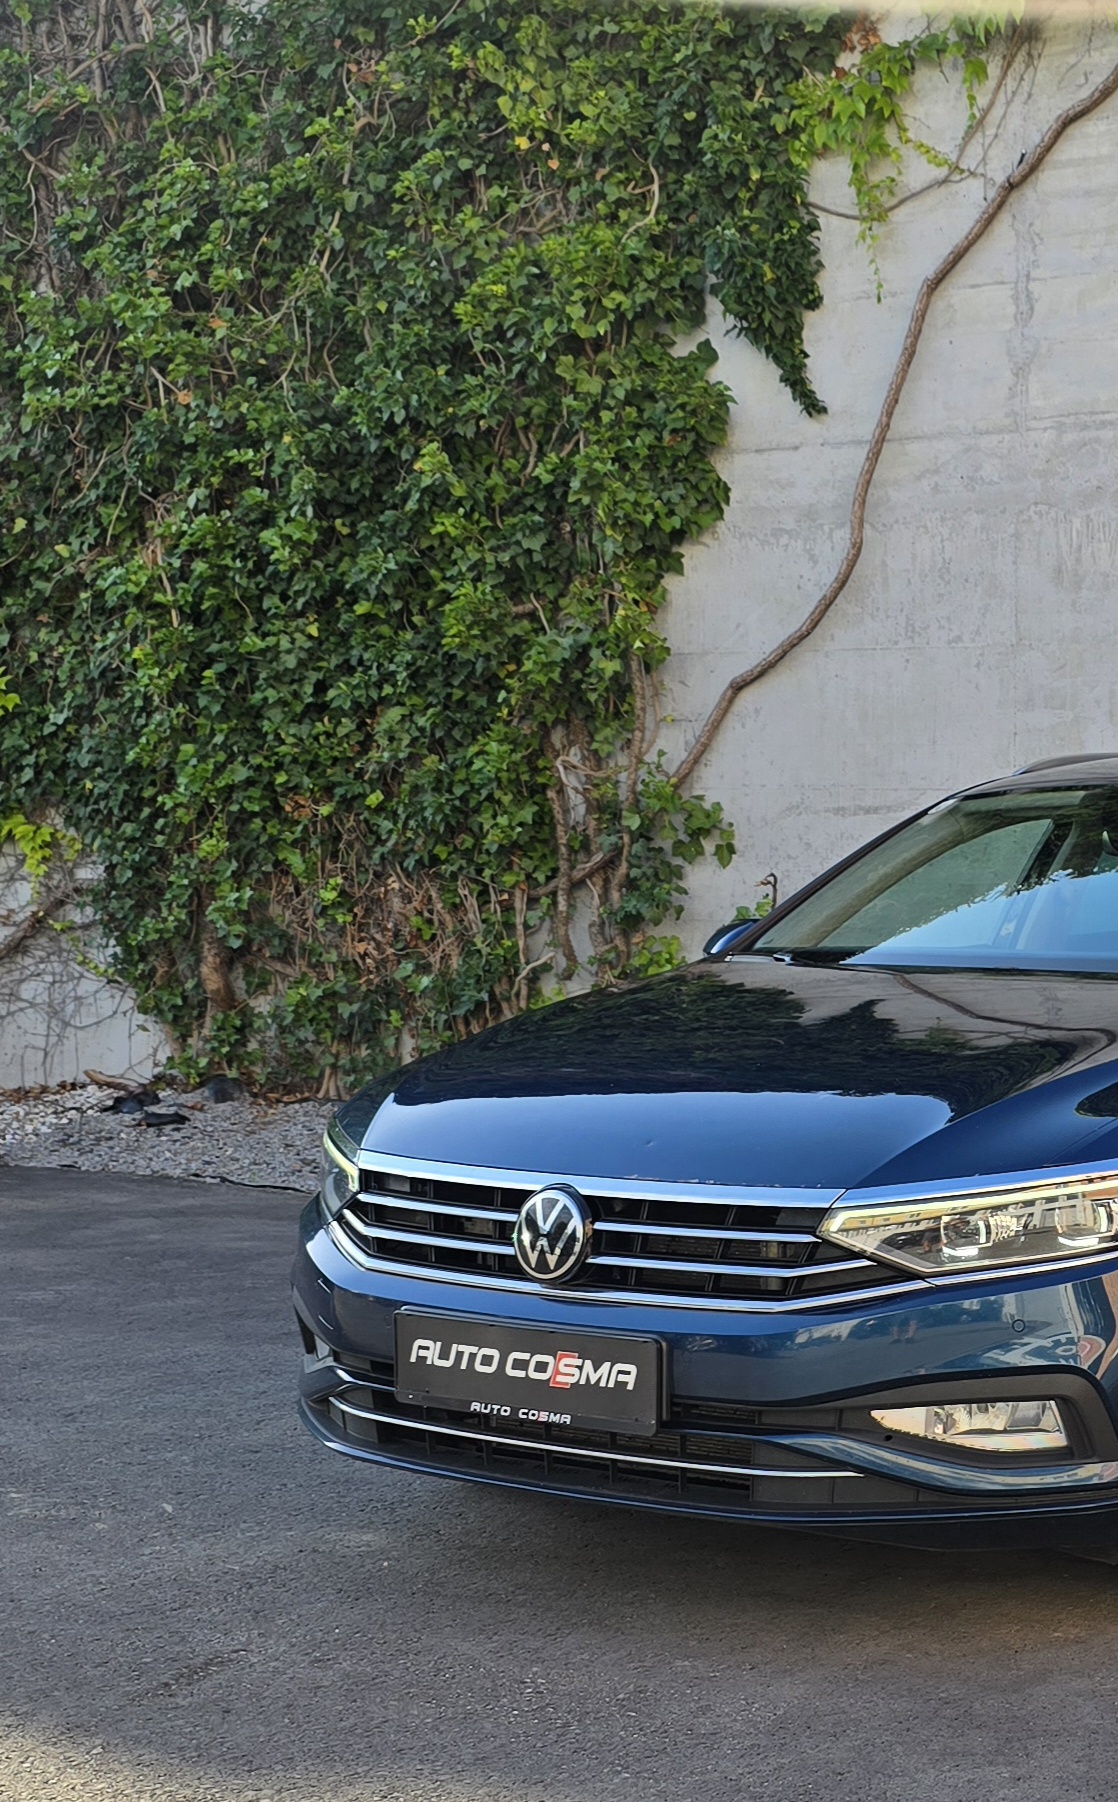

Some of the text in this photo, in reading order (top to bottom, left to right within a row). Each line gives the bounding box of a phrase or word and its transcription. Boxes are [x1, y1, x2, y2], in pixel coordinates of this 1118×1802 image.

[515, 1190, 584, 1280] VW
[410, 1338, 638, 1391] AUTO COSMA
[470, 1401, 571, 1425] AUTO COSMA
